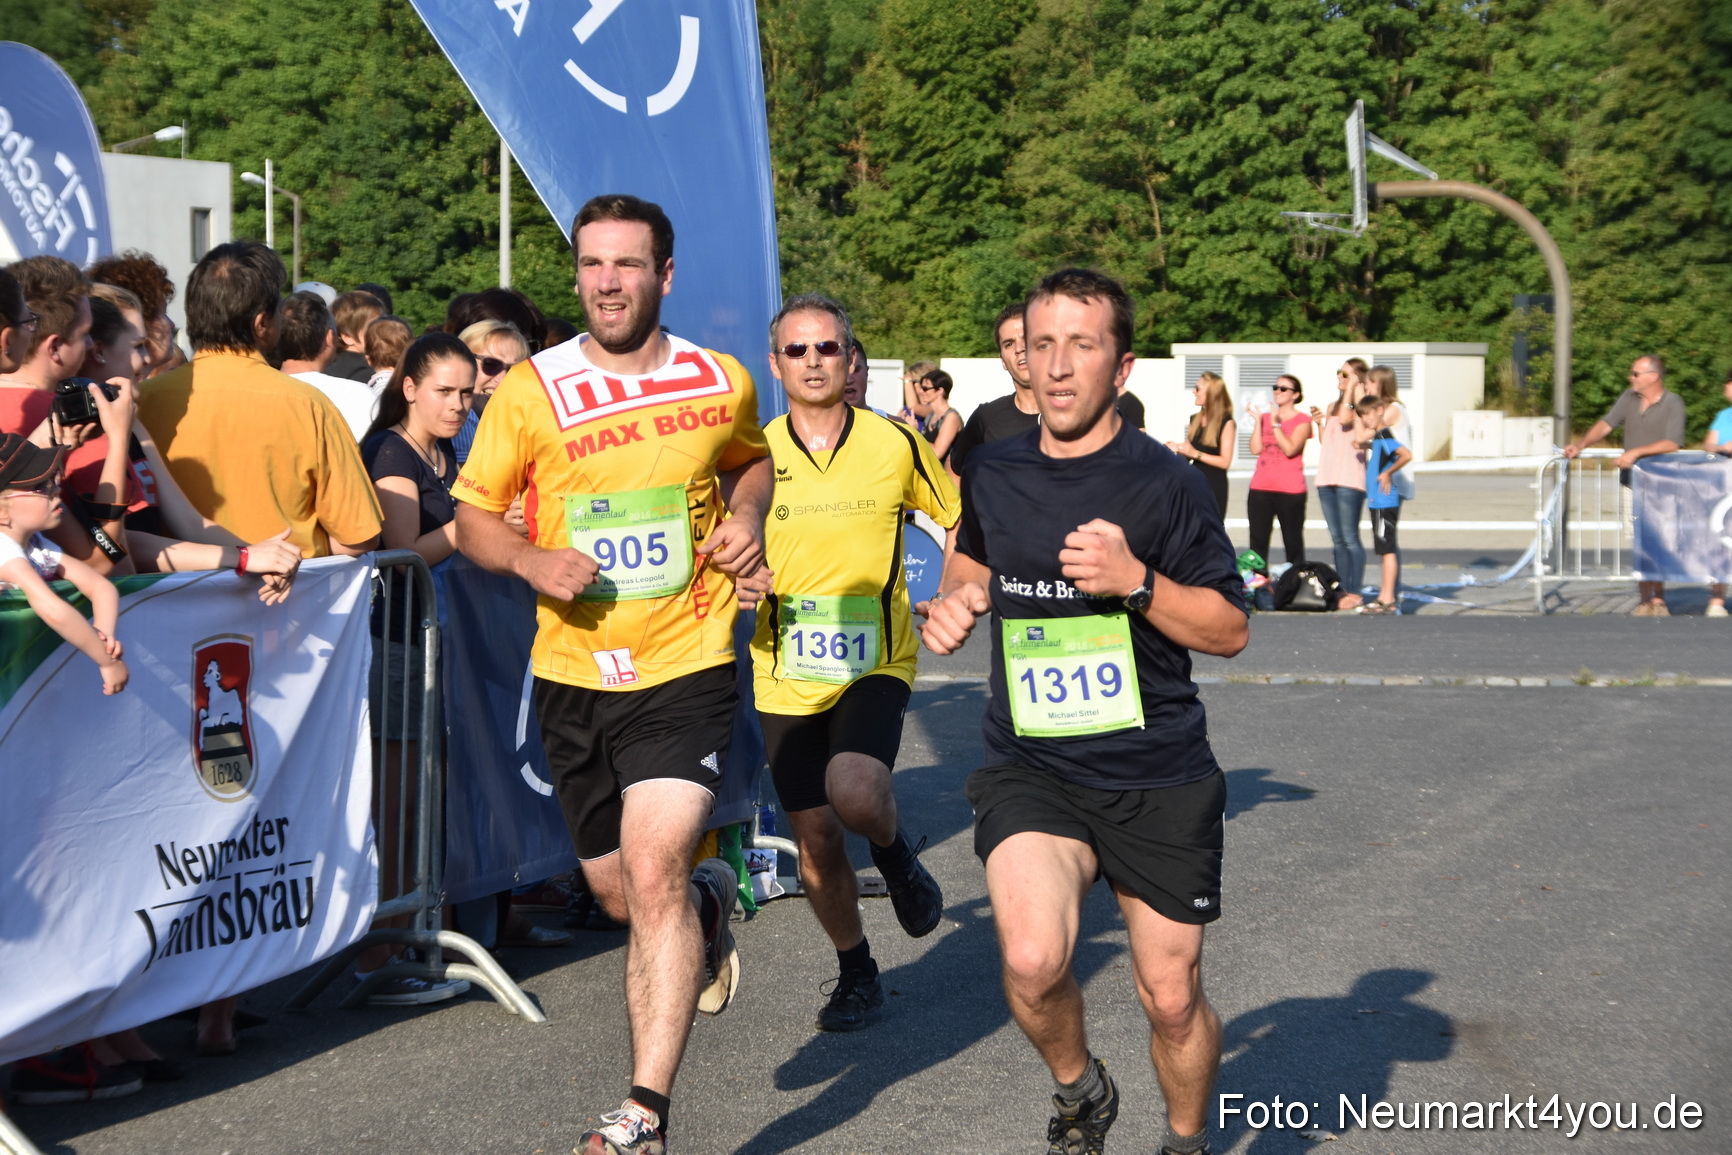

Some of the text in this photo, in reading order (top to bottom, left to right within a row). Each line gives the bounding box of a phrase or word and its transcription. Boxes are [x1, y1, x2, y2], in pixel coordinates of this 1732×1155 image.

[564, 405, 733, 462] MAX BÖGL
[584, 508, 627, 520] firmenlauf
[793, 499, 876, 516] SPANGLER
[831, 509, 877, 518] AUTOMATION
[90, 526, 118, 555] SONY
[593, 531, 669, 572] 905
[603, 573, 665, 586] Andreas Leopold
[999, 575, 1107, 600] Seitz & Brau
[791, 630, 866, 661] 1361
[1020, 638, 1061, 648] firmenlauf
[796, 662, 818, 670] Michael
[819, 664, 863, 674] Spangler-Lang
[1020, 662, 1122, 704] 1319
[1048, 708, 1100, 719] Michael Sittel
[211, 761, 243, 786] 1628
